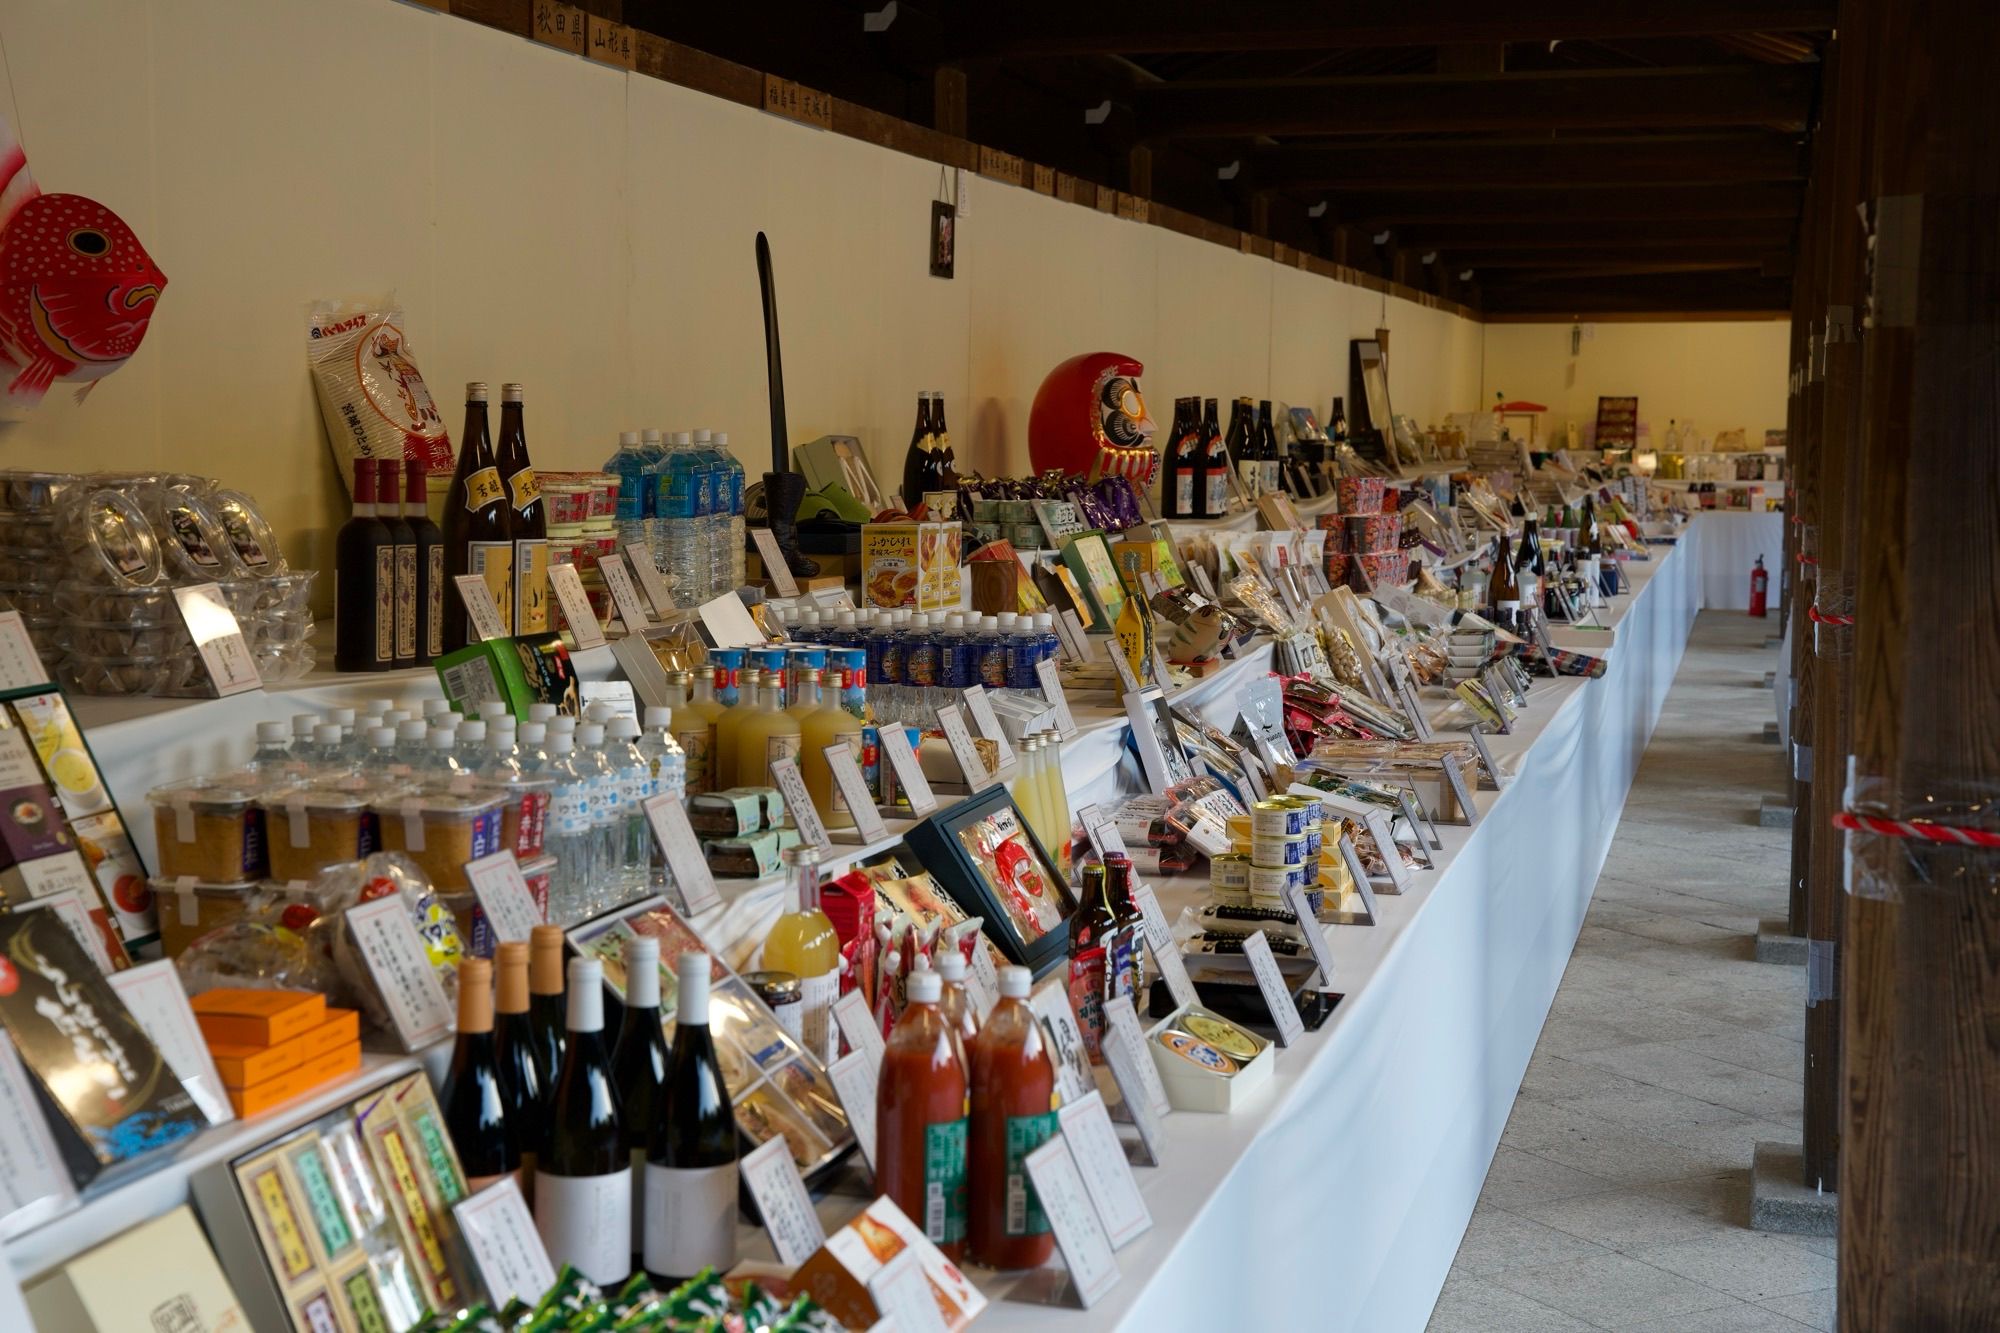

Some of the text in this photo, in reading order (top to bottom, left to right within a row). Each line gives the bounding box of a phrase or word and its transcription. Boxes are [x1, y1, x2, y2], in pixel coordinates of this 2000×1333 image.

[537, 4, 582, 46] 秋田県
[594, 27, 631, 61] 山形県
[770, 85, 796, 112] 福島県
[322, 315, 367, 337] パールライス
[342, 402, 375, 459] 宮城ひとめ
[868, 536, 912, 547] ふかひれ
